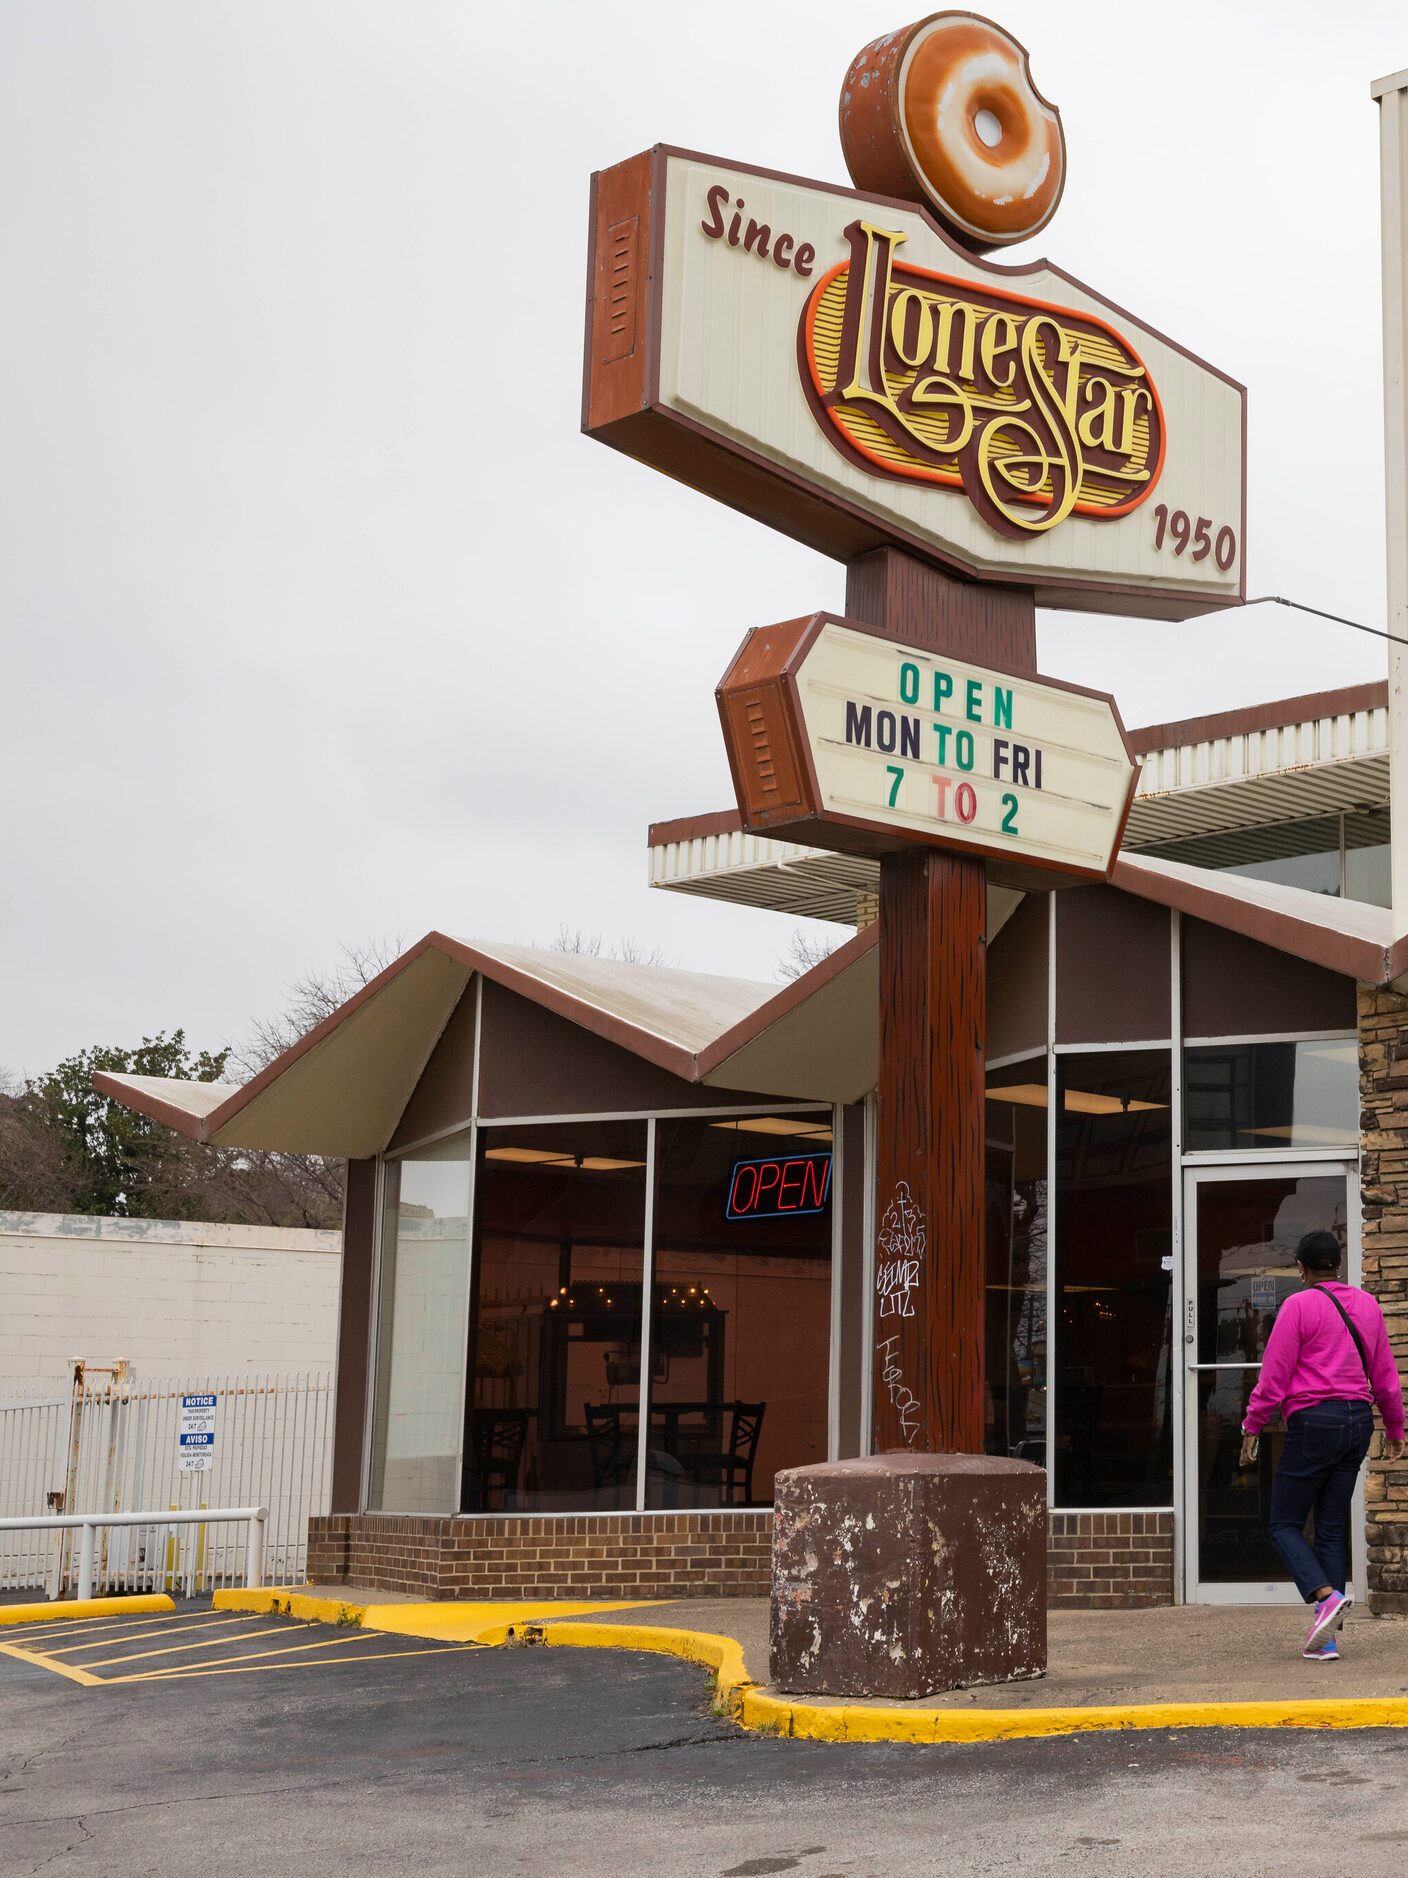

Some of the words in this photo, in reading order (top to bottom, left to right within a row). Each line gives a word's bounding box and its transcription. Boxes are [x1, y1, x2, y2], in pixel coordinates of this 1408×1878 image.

[700, 184, 817, 278] Since
[842, 220, 1032, 453] Lone
[978, 316, 1153, 532] Star
[1154, 503, 1237, 572] 1950
[899, 662, 1013, 730] OPEN
[845, 700, 921, 760] MON
[932, 722, 975, 771] TO
[993, 738, 1042, 789] FRI
[885, 765, 905, 808] 7
[931, 775, 977, 825] TO
[1001, 792, 1019, 836] 2
[732, 1159, 829, 1213] OPEN
[1253, 1279, 1274, 1292] OPEN
[185, 1397, 214, 1406] NOTICE
[186, 1434, 208, 1444] AVISO
